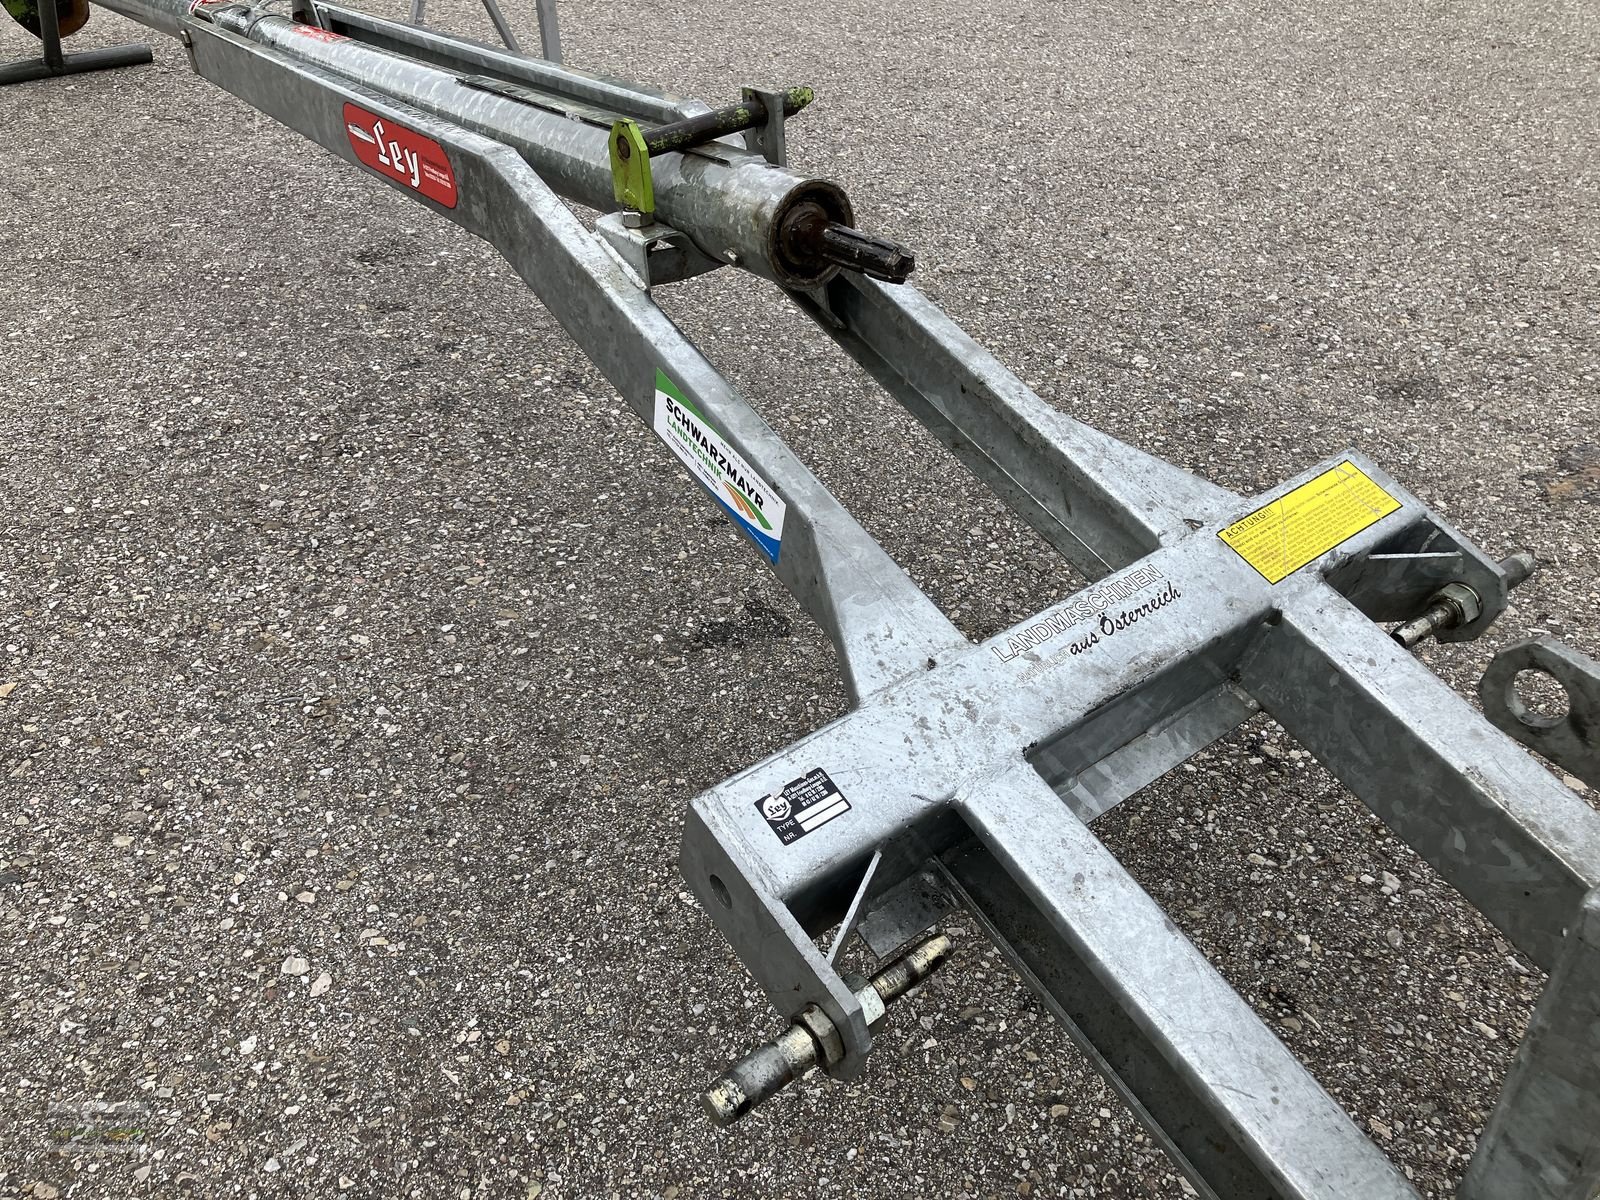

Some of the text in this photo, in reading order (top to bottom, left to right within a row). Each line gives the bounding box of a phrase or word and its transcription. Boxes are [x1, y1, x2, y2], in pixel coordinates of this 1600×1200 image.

[666, 397, 764, 511] SCHWARZMAYR
[667, 415, 723, 481] LANDTECHNIK
[1225, 508, 1274, 538] ACHTUNG!!!
[991, 564, 1164, 663] LANDMASCHINEN
[1070, 631, 1099, 656] aus
[1098, 581, 1181, 636] Österreich
[777, 819, 796, 832] TYPE
[783, 832, 798, 842] NR.
